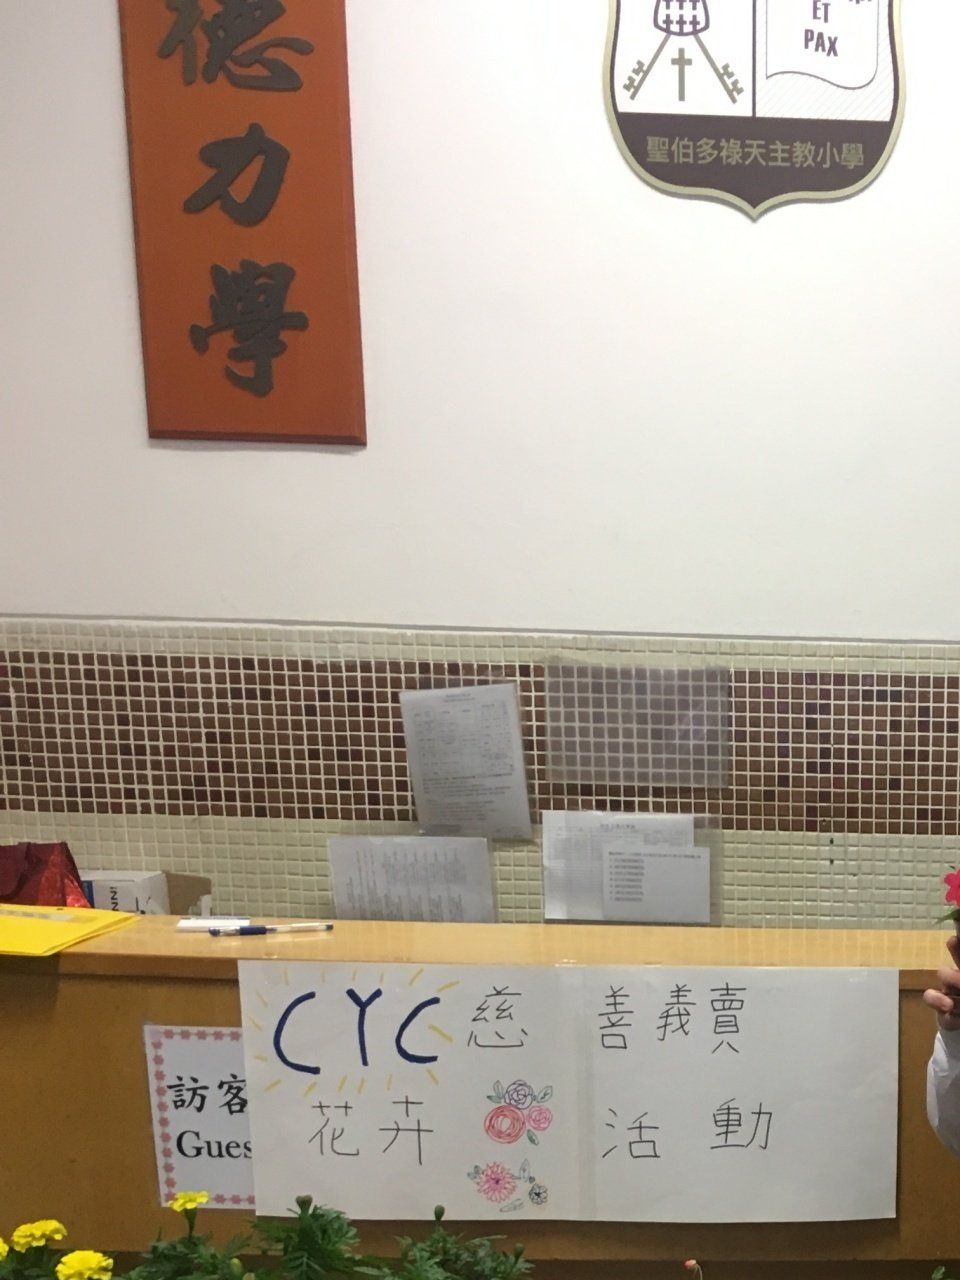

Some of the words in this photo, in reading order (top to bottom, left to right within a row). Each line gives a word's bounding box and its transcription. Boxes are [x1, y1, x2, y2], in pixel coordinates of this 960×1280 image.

[812, 0, 831, 23] ET
[804, 28, 838, 57] PAX
[645, 135, 865, 169] 聖伯多祿天主教小學
[273, 987, 441, 1075] CYC
[166, 1073, 248, 1115] 訪客
